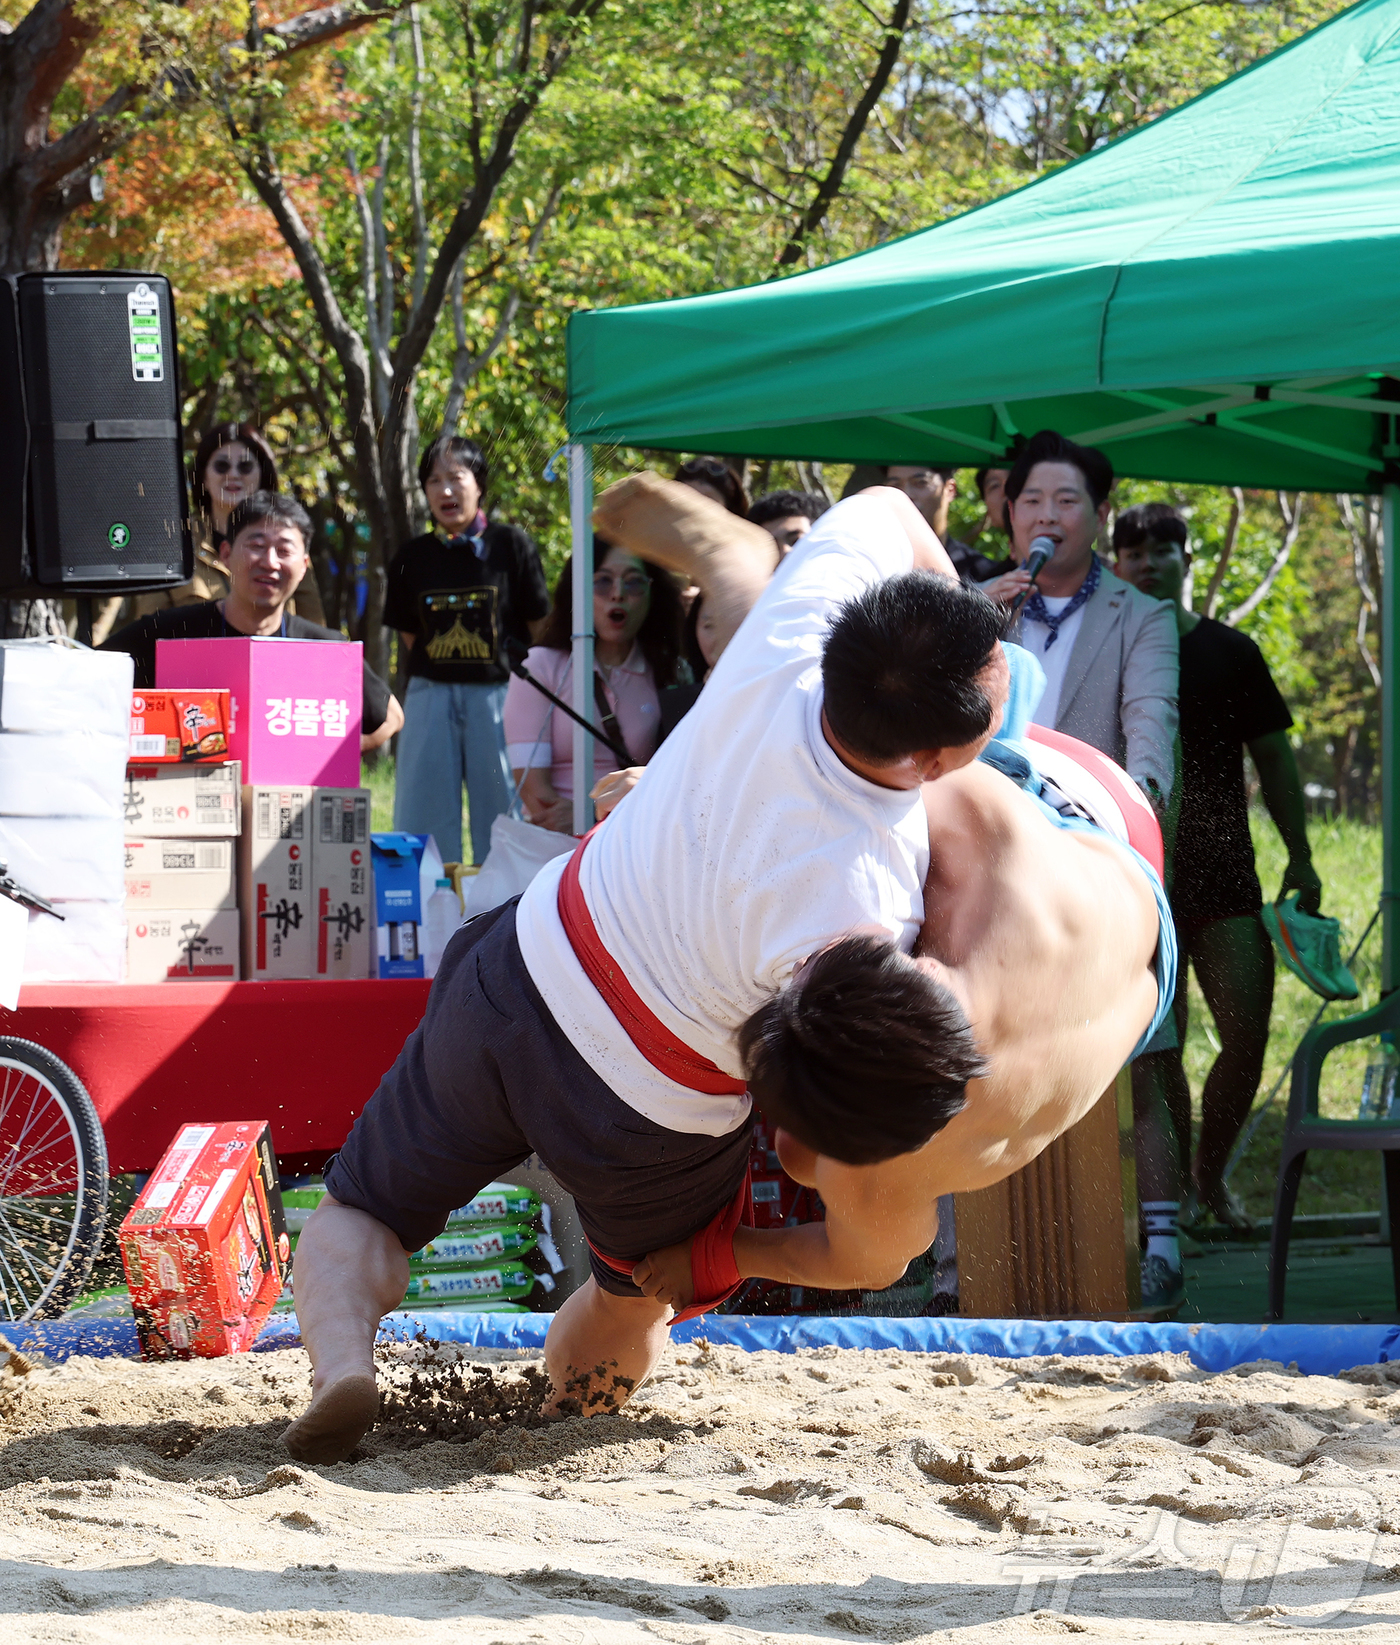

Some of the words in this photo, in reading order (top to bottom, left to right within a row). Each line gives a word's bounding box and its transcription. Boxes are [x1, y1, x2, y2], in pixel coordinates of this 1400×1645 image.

[264, 697, 350, 738] 경품함
[260, 897, 304, 939] 辛
[322, 901, 366, 943] 辛
[178, 918, 209, 975] 辛
